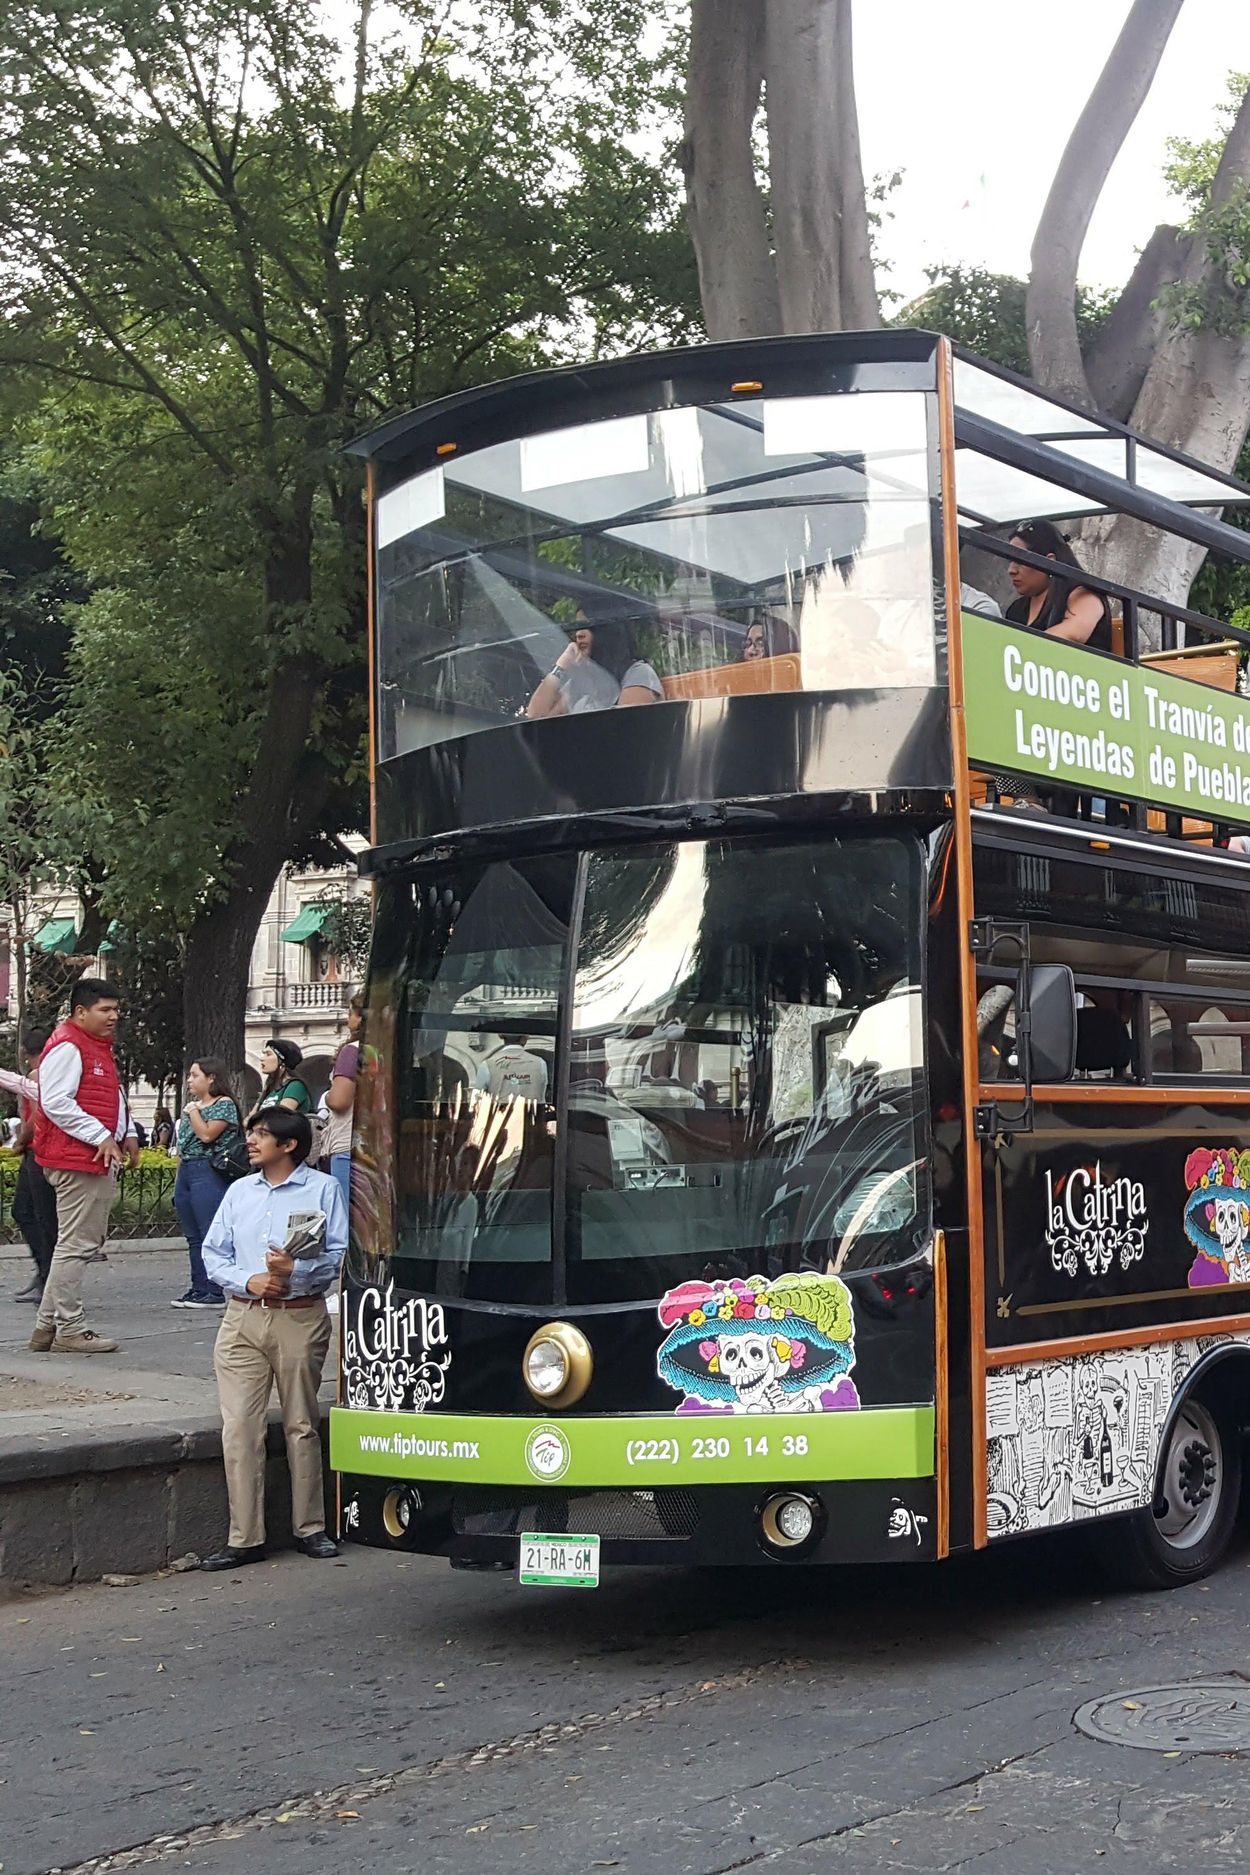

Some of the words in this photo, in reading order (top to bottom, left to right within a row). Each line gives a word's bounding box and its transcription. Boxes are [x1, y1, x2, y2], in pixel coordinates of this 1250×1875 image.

[1003, 645, 1101, 713] Conoce
[1109, 679, 1131, 721] el
[1144, 685, 1227, 748] Tranvía
[1015, 709, 1135, 779] Leyendas
[1149, 745, 1176, 789] de
[1045, 1169, 1065, 1232] la
[1065, 1159, 1147, 1232] Catrina
[342, 1289, 358, 1362] la
[358, 1276, 449, 1361] Catrina
[359, 1432, 480, 1460] www.tiptours.mx
[626, 1438, 680, 1465] (222)
[691, 1437, 730, 1458] 230
[744, 1436, 768, 1457] 14
[782, 1435, 809, 1456] 38
